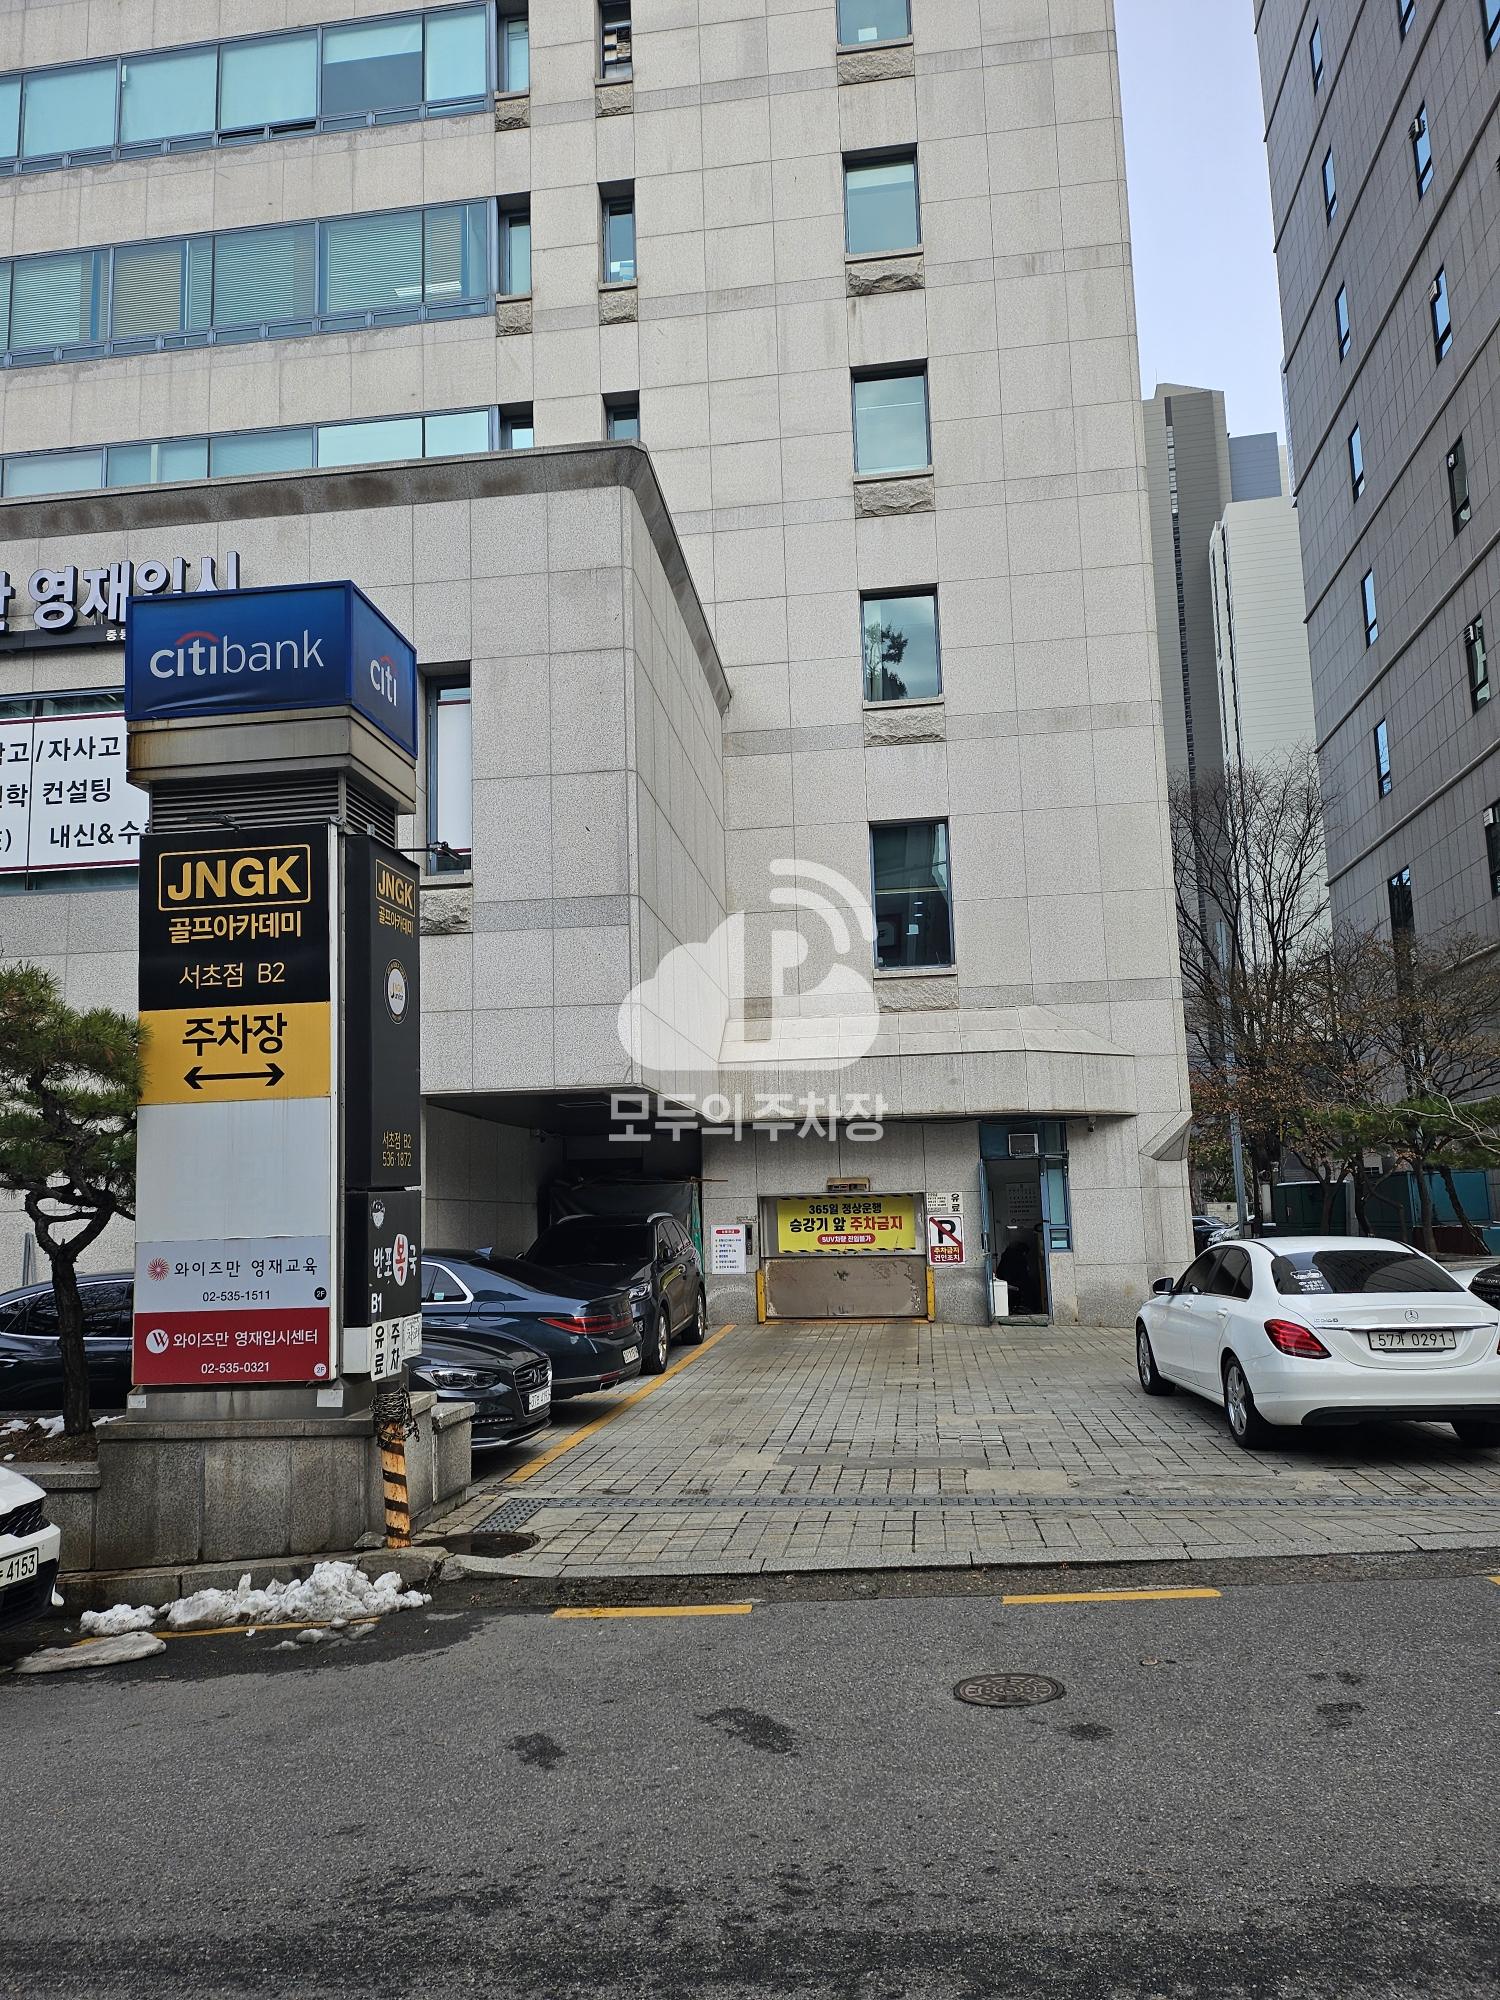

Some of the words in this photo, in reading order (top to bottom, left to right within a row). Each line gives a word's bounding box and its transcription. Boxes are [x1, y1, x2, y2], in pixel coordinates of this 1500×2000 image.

[149, 629, 325, 679] citibank
[369, 656, 398, 707] citi
[42, 778, 111, 805] 컨설팅
[167, 855, 301, 901] JNGK
[377, 870, 413, 910] JNGK
[168, 911, 301, 944] 골프아카데미
[179, 962, 243, 989] 서초점
[257, 962, 286, 984] B2
[182, 1012, 287, 1056] 주차장
[382, 1131, 401, 1150] 서초점
[404, 1133, 412, 1149] B2
[808, 1203, 839, 1214] 365일
[842, 1202, 882, 1214] 정상운행
[951, 1193, 960, 1212] 유료
[790, 1217, 828, 1232] 승강기
[833, 1217, 846, 1231] 앞
[850, 1215, 903, 1231] 주차금지
[934, 1247, 959, 1255] 주차금지
[934, 1254, 960, 1262] 견인조치
[174, 1260, 241, 1278] 와이즈만
[251, 1257, 318, 1278] 영재교육
[202, 1290, 270, 1302] 02-535-1511
[316, 1290, 326, 1298] 2F
[371, 1292, 383, 1314] B1
[173, 1331, 230, 1348] 와이즈만
[234, 1329, 318, 1347] 영재입시센터
[1411, 1333, 1446, 1346] 0291
[374, 1325, 385, 1376] 유료
[201, 1362, 270, 1374] 02-535-0321
[316, 1366, 325, 1374] 2F
[6, 1554, 36, 1581] 4153
